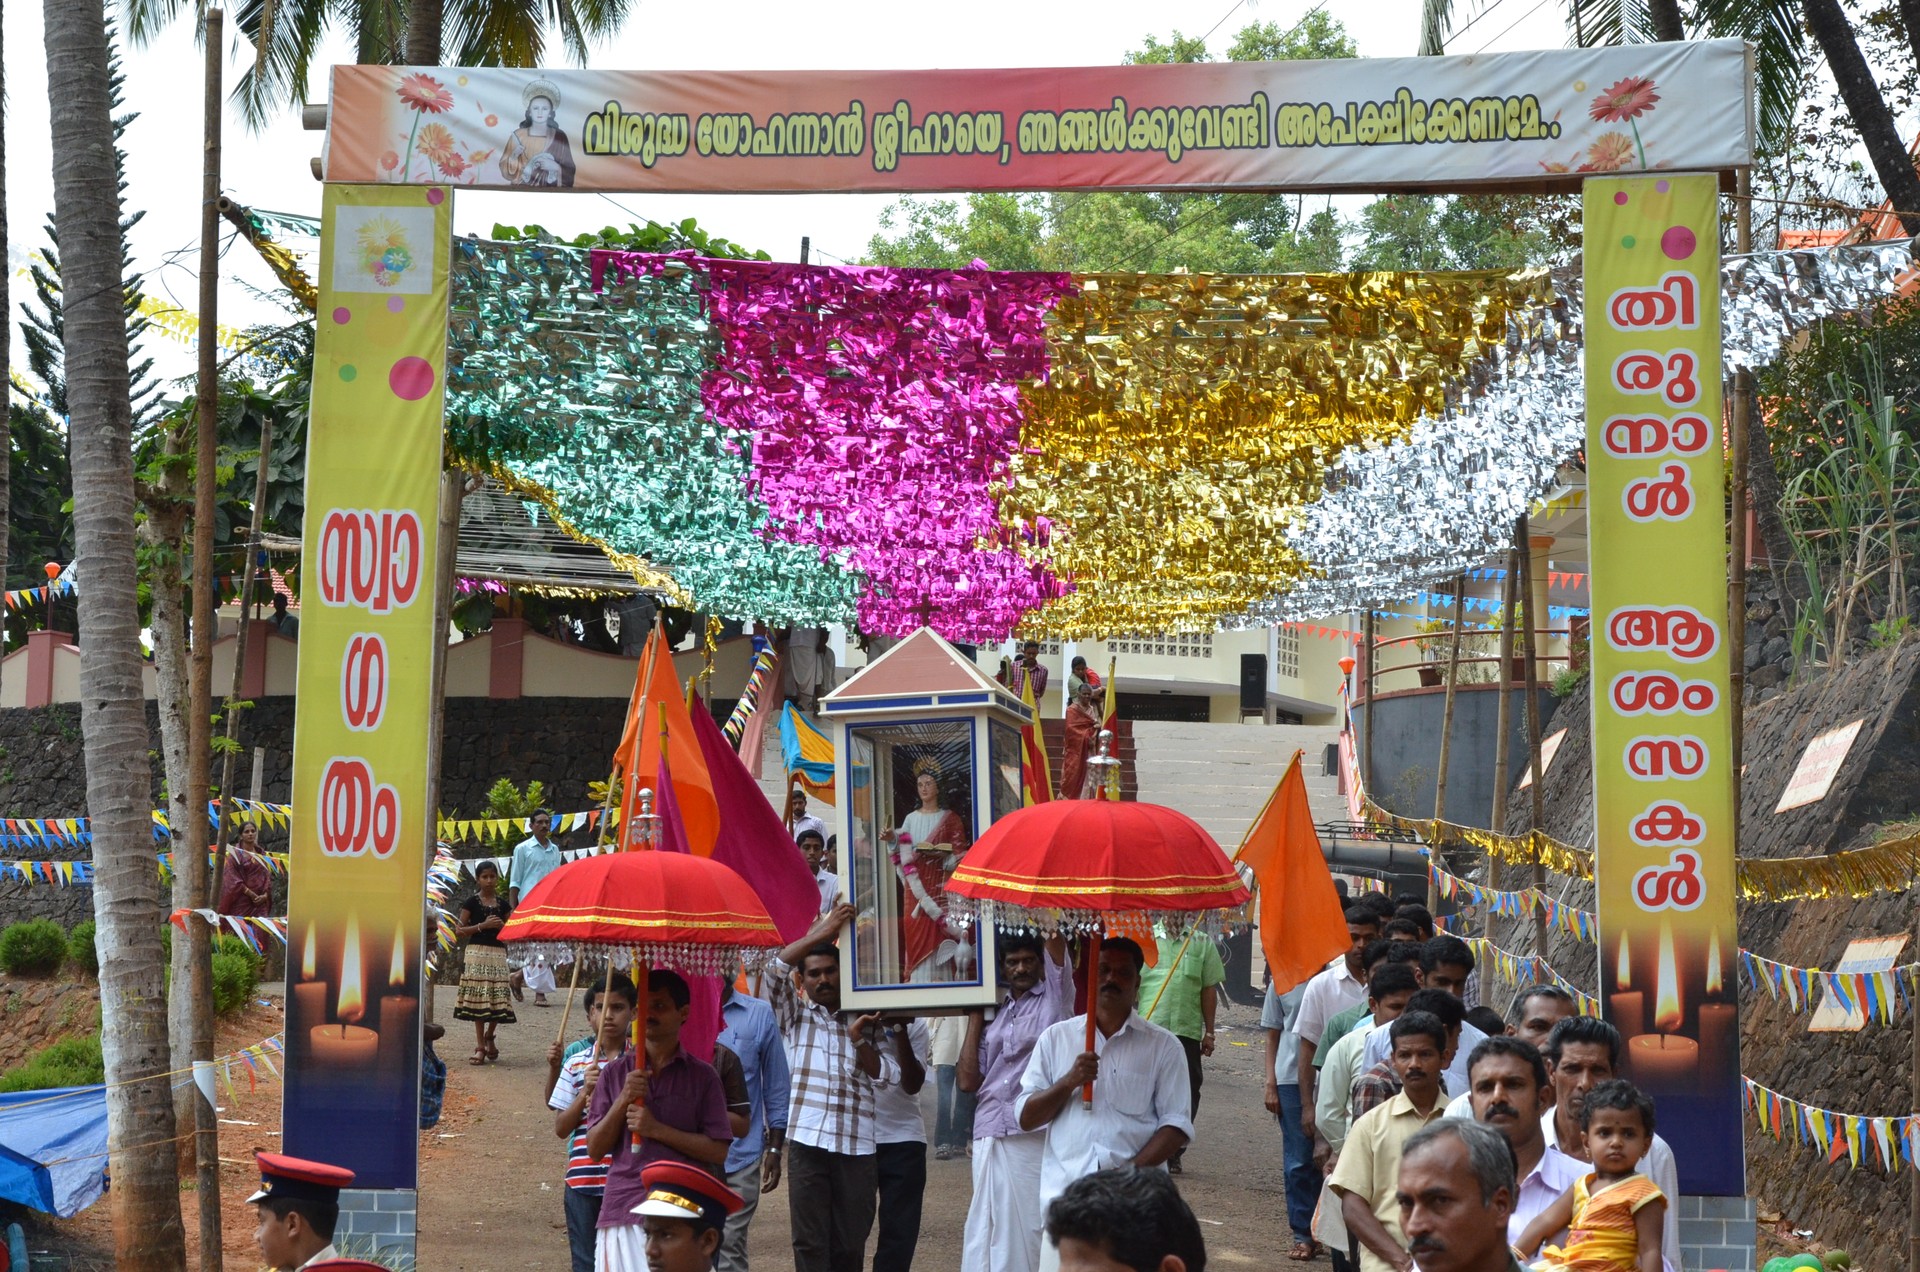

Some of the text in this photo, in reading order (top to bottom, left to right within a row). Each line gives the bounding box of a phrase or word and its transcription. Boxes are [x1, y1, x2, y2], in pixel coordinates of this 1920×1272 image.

[584, 101, 689, 168] വിശുദ്ധ
[697, 100, 864, 156] യോഹന്നാൻ
[1018, 92, 1269, 162] ഞങ്ങൾക്കുവേണ്ടി
